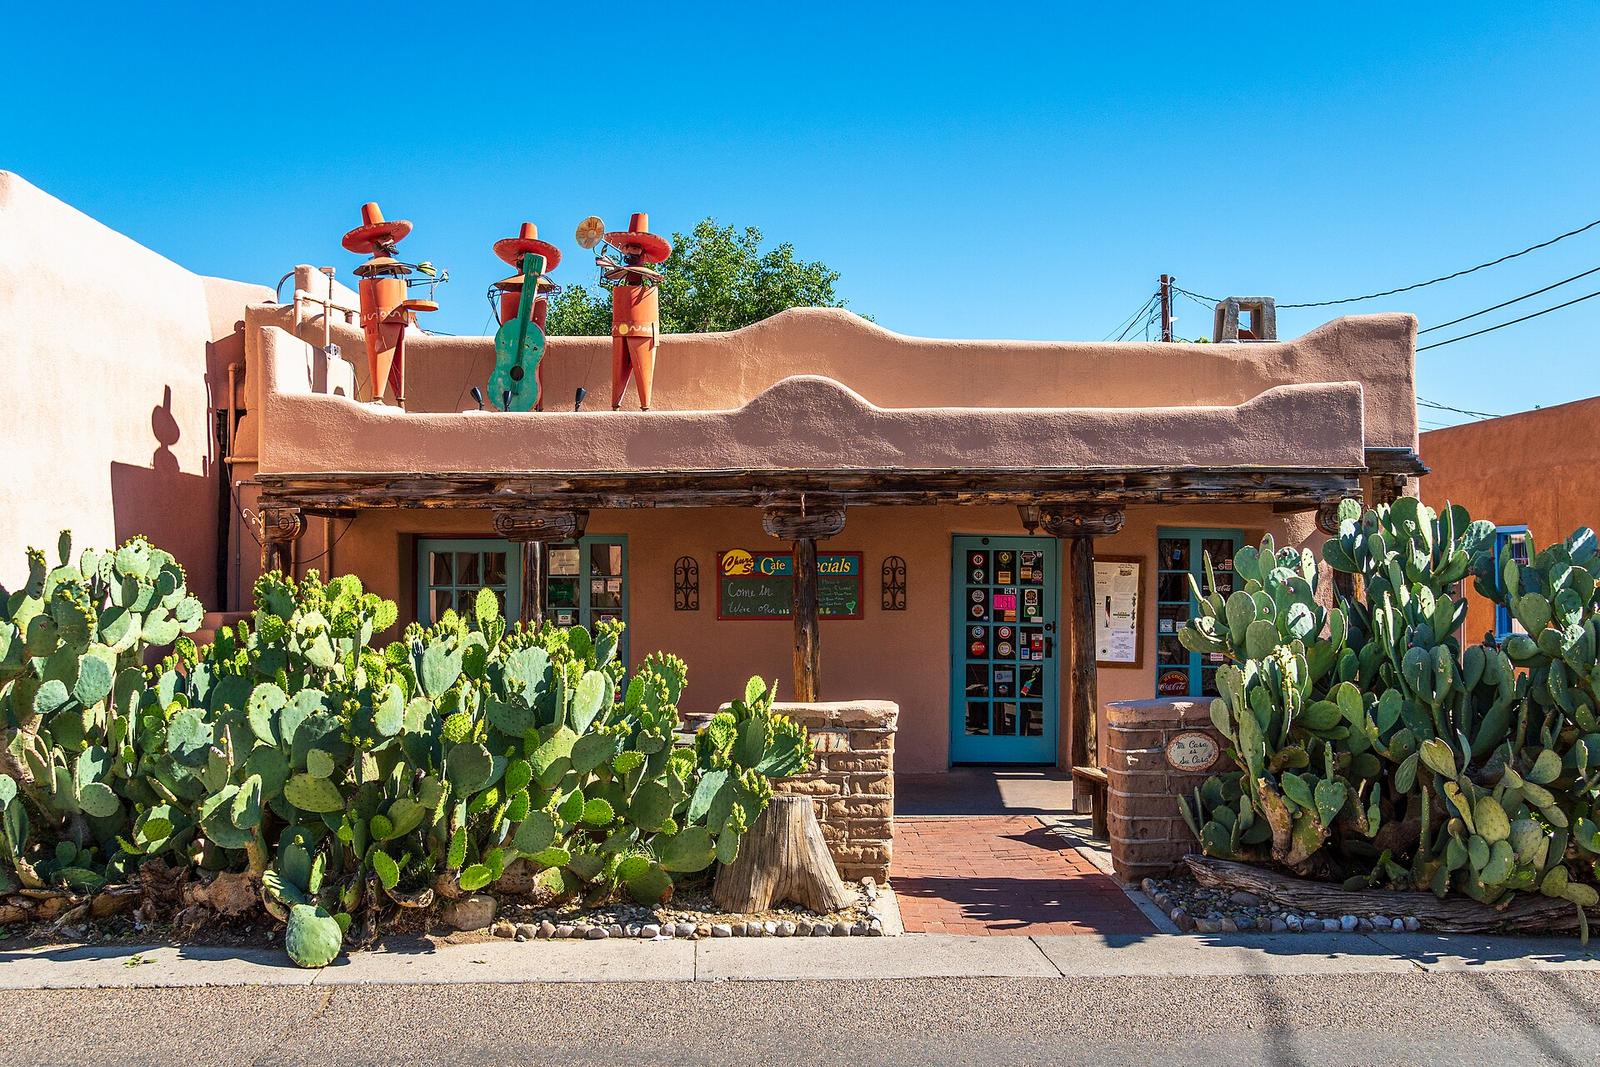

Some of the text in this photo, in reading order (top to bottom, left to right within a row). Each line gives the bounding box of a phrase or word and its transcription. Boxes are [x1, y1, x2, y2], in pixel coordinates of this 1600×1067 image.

[760, 557, 786, 575] Cafe
[727, 582, 756, 597] Come
[1189, 740, 1208, 749] Casa
[1191, 755, 1209, 764] Casa
